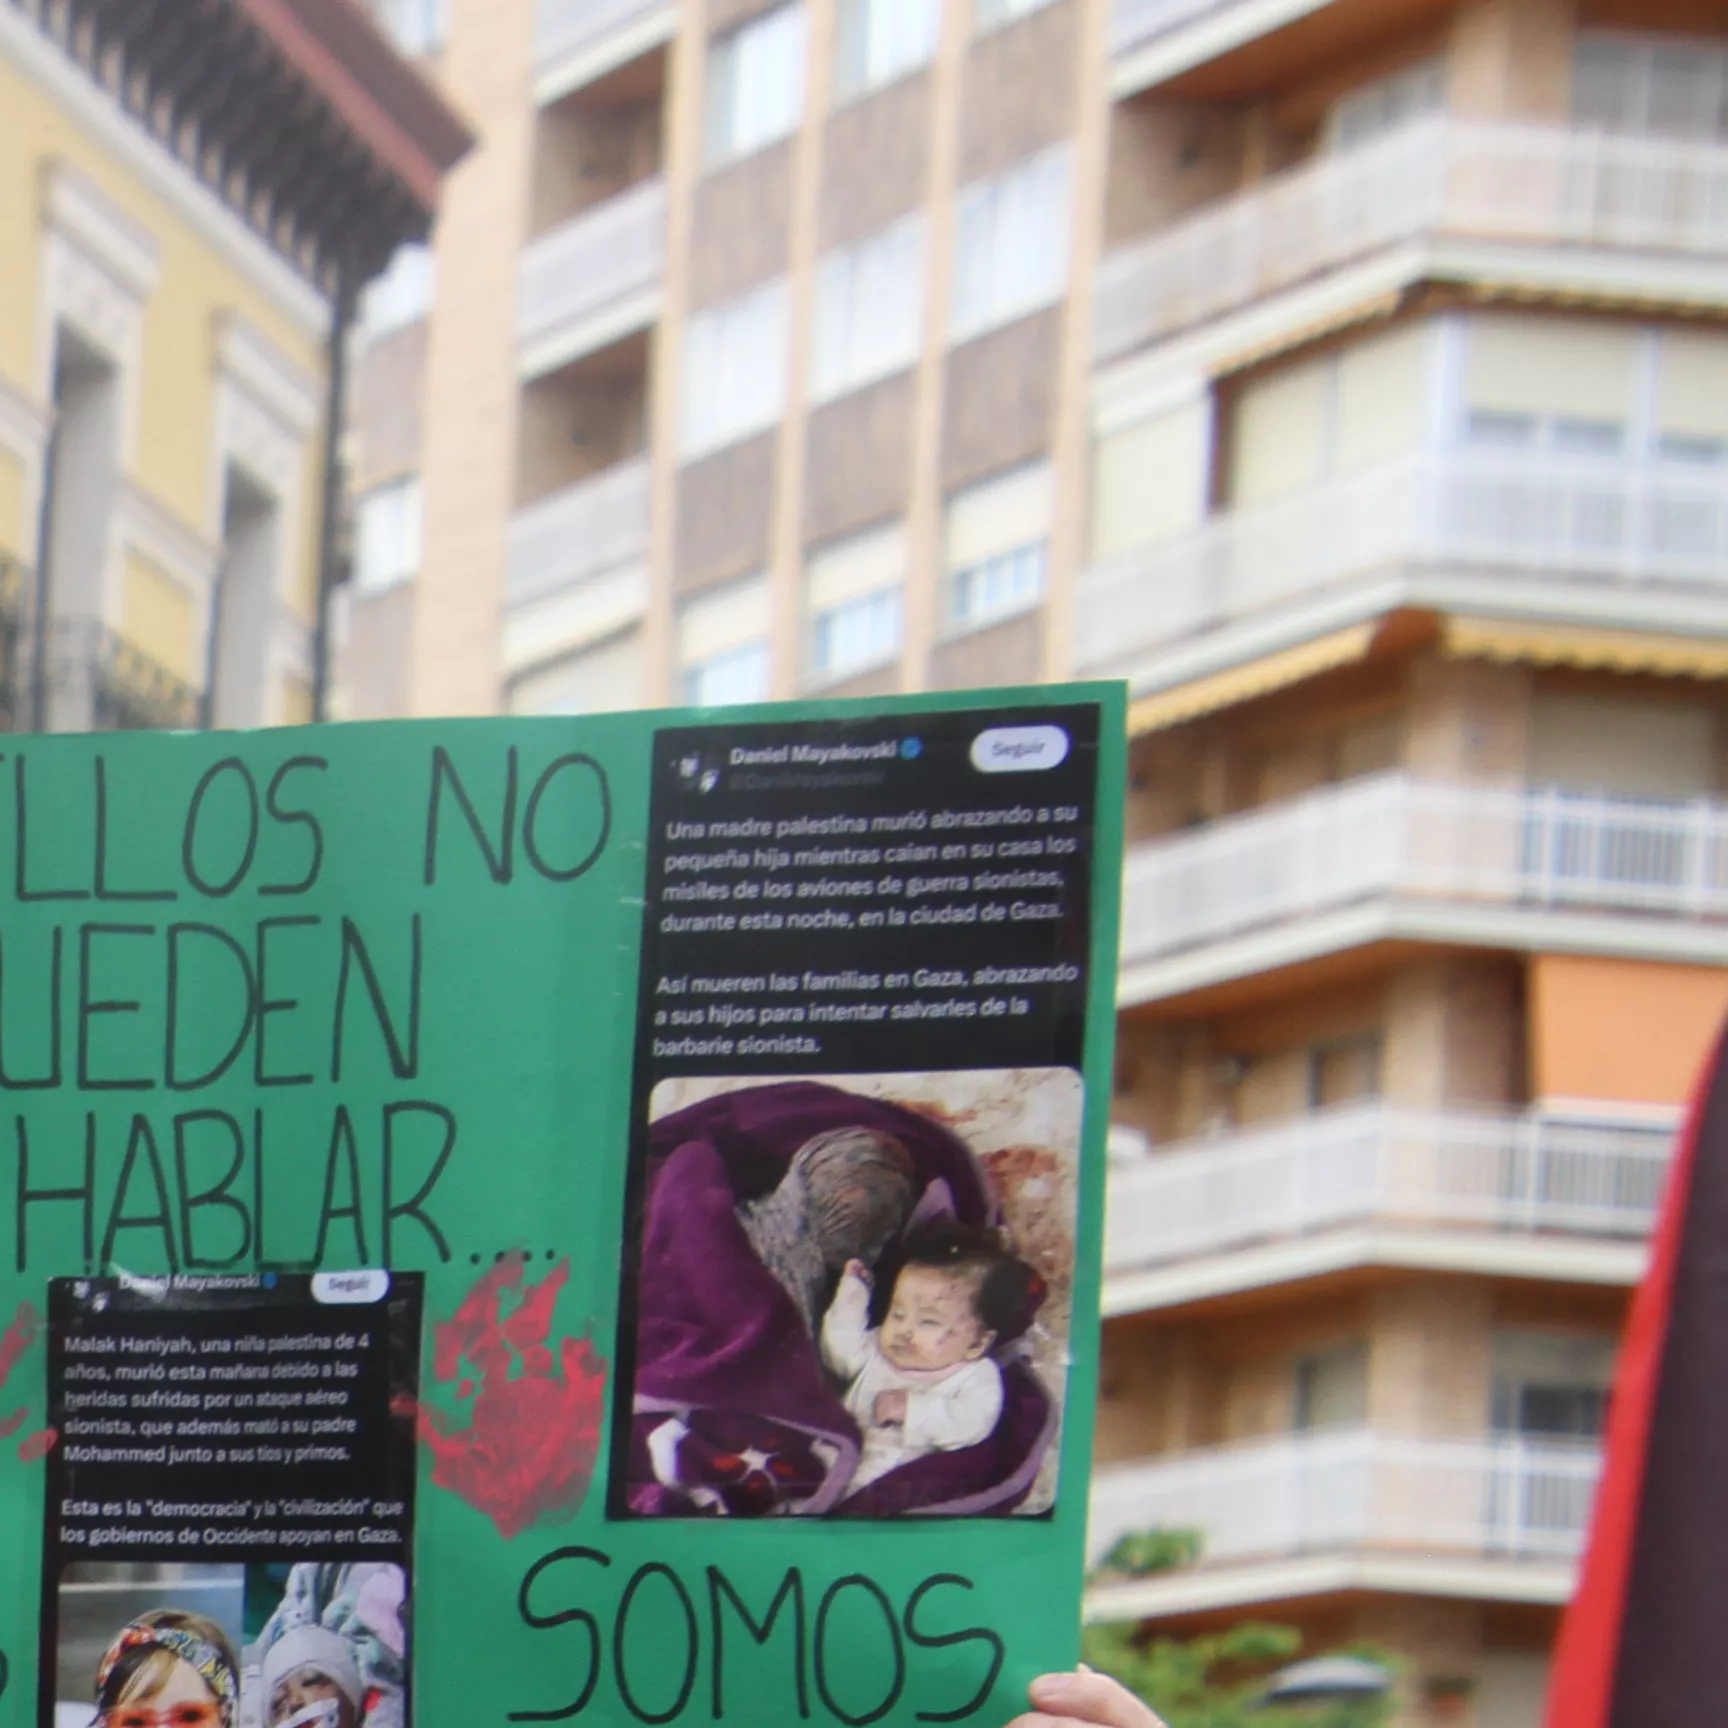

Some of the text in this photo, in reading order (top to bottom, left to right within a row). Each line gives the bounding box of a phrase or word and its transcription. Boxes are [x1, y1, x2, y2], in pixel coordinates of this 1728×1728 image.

[792, 739, 897, 768] Mayakovski
[423, 744, 613, 885] NO
[666, 802, 1078, 840] Una madre palestina murió abrazando a su
[663, 846, 750, 875] pequeña
[753, 845, 791, 873] hija
[793, 841, 884, 867] mientras
[939, 843, 967, 861] en
[970, 841, 994, 860] su
[996, 839, 1043, 857] casa
[1046, 832, 1076, 854] los
[662, 878, 731, 903] misiles
[731, 878, 760, 900] de
[762, 877, 793, 900] los
[794, 873, 874, 899] aviones
[875, 873, 904, 895] de
[905, 873, 970, 898] guerra
[659, 897, 1065, 933] durante esta noche, en la ciudad de Gaza.
[690, 975, 766, 995] mueren
[769, 970, 799, 993] las
[801, 966, 881, 993] familias
[882, 972, 910, 989] en
[911, 965, 970, 990] Gaza,
[971, 960, 1080, 986] abrazando
[654, 994, 1029, 1029] a sus hijos para intentar salvarles de la
[652, 1030, 822, 1058] barbarie sionista.
[173, 1274, 259, 1293] Mayakovski
[64, 1331, 370, 1358] Malak Haniyah, una niña palestina de 4
[63, 1358, 359, 1383] años, murió esta mañana debido a las
[64, 1386, 349, 1412] heridas sufridas por un ataque aéreo
[64, 1414, 357, 1439] sionista, que además mató a su padre
[63, 1442, 166, 1464] Mohammed
[166, 1443, 213, 1466] junto
[215, 1448, 226, 1462] a
[228, 1447, 255, 1462] sus
[283, 1448, 293, 1465] y
[293, 1442, 351, 1464] primos.
[61, 1497, 99, 1516] Esta
[100, 1501, 123, 1516] es
[125, 1498, 142, 1516] la
[252, 1504, 263, 1520] y
[264, 1499, 276, 1516] la
[371, 1501, 404, 1519] que
[59, 1524, 403, 1547] los gobiernos de Occidente apoyan en Gaza.
[507, 1545, 1005, 1728] SOMOS
